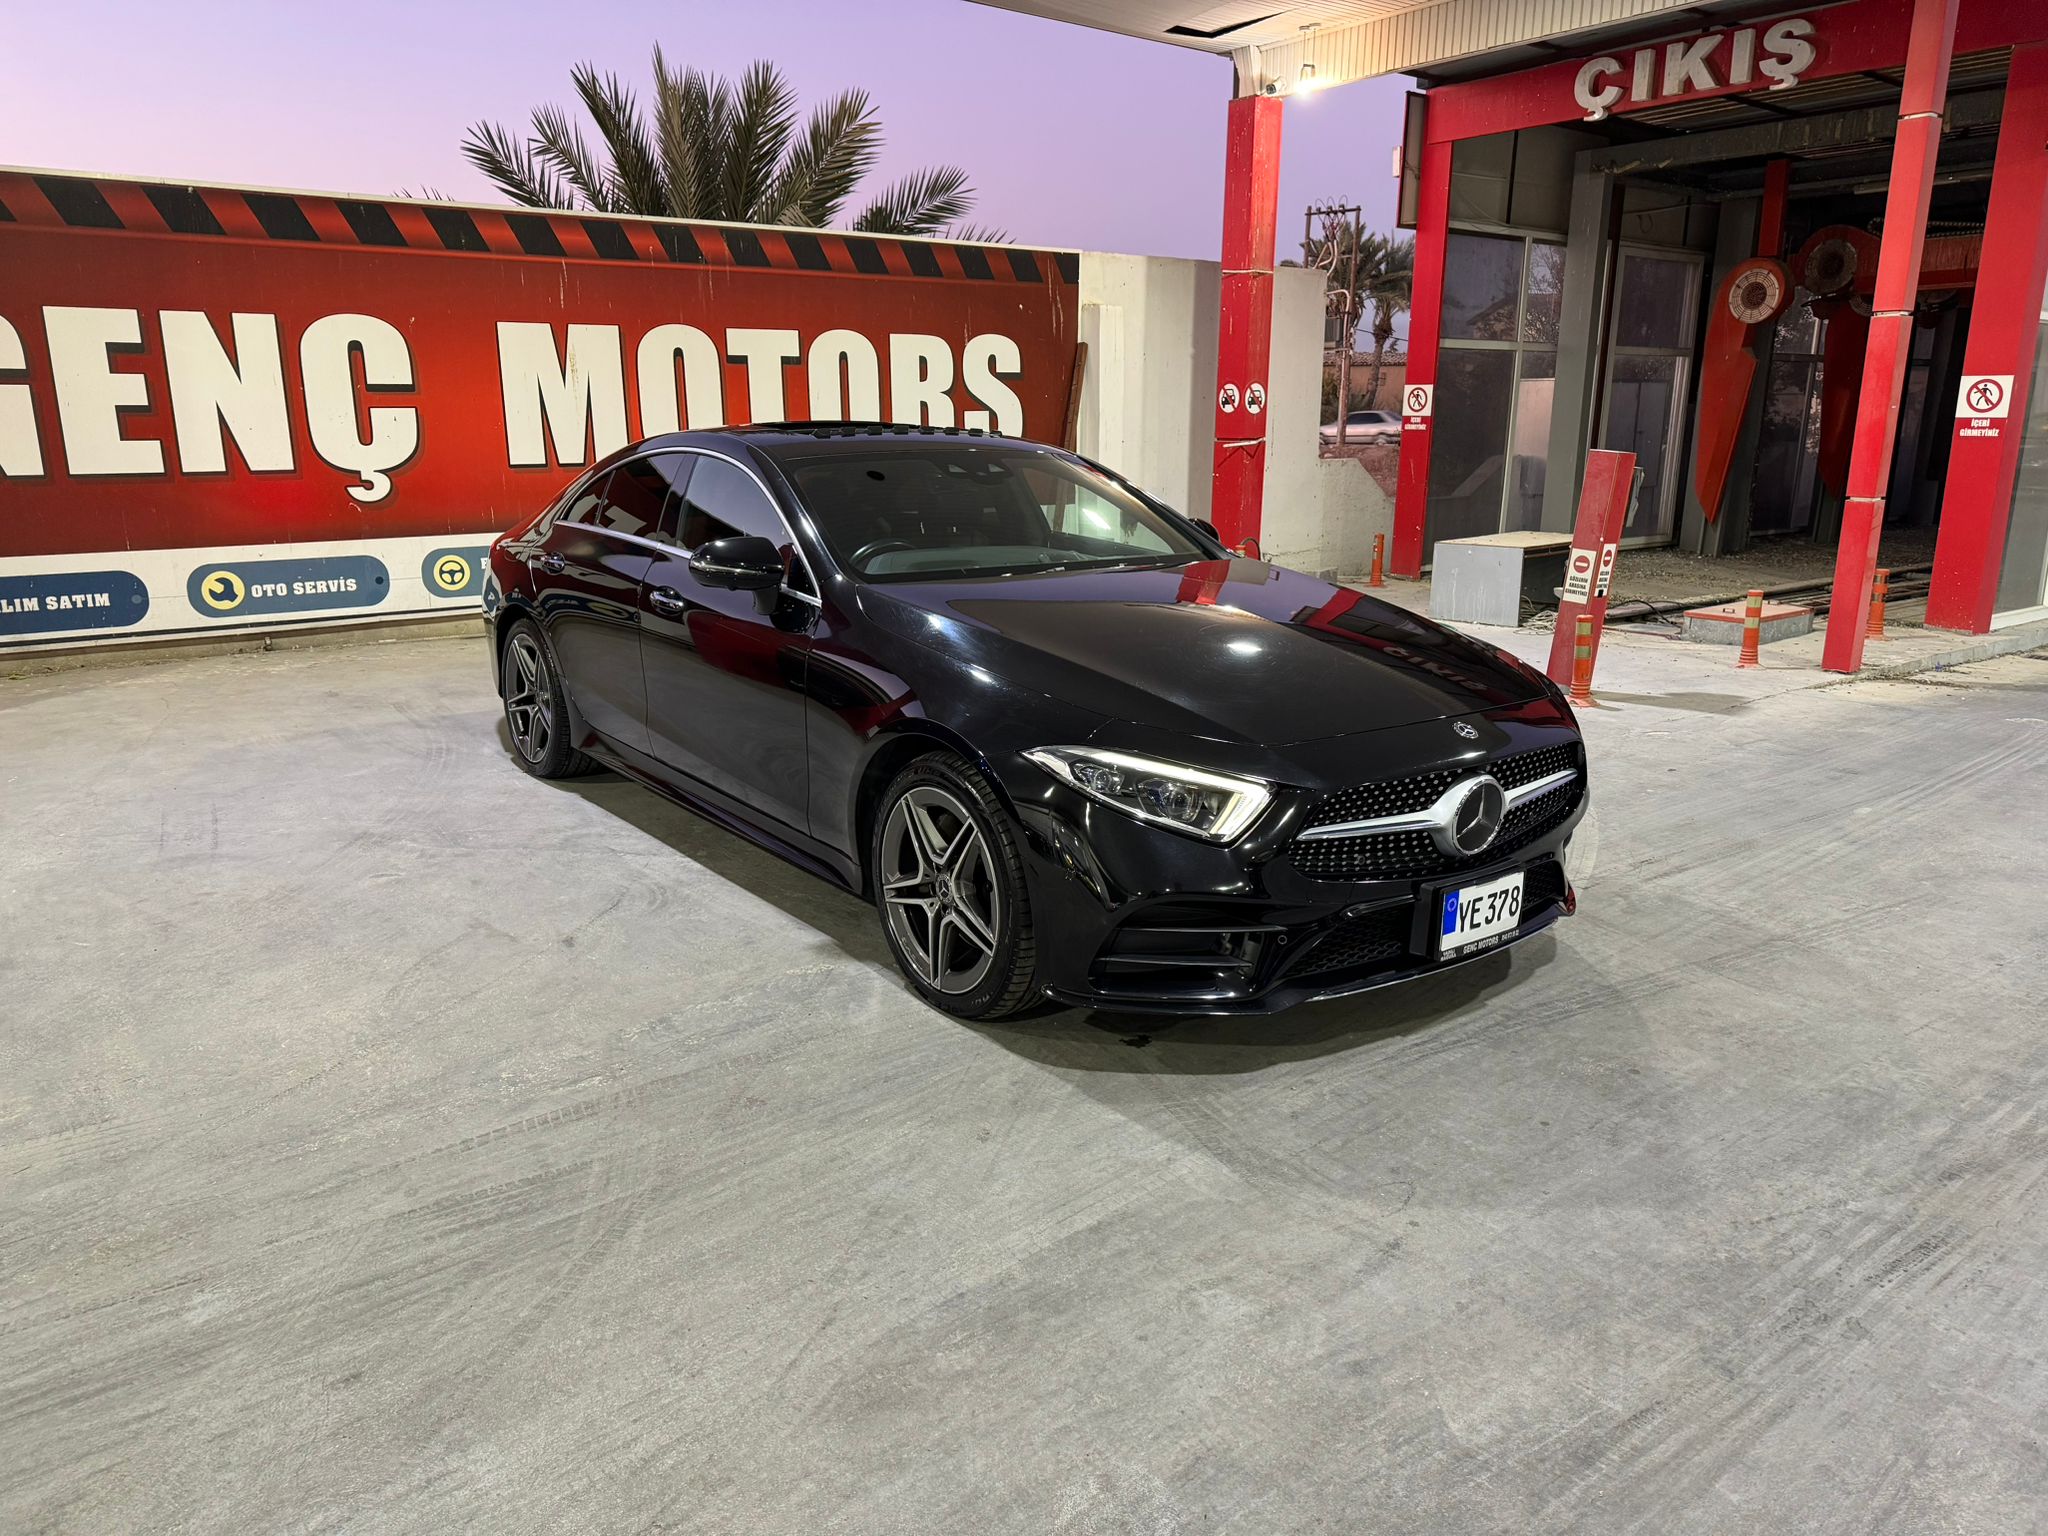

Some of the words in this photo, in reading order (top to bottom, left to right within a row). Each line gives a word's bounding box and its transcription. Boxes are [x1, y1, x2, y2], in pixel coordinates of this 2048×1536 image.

[1574, 18, 1817, 122] ÇIKIŞ
[496, 322, 1024, 467] MOTORS
[0, 597, 39, 613] LIM
[46, 593, 110, 610] SATIM
[251, 582, 287, 598] OTO
[293, 576, 357, 595] SERVİS
